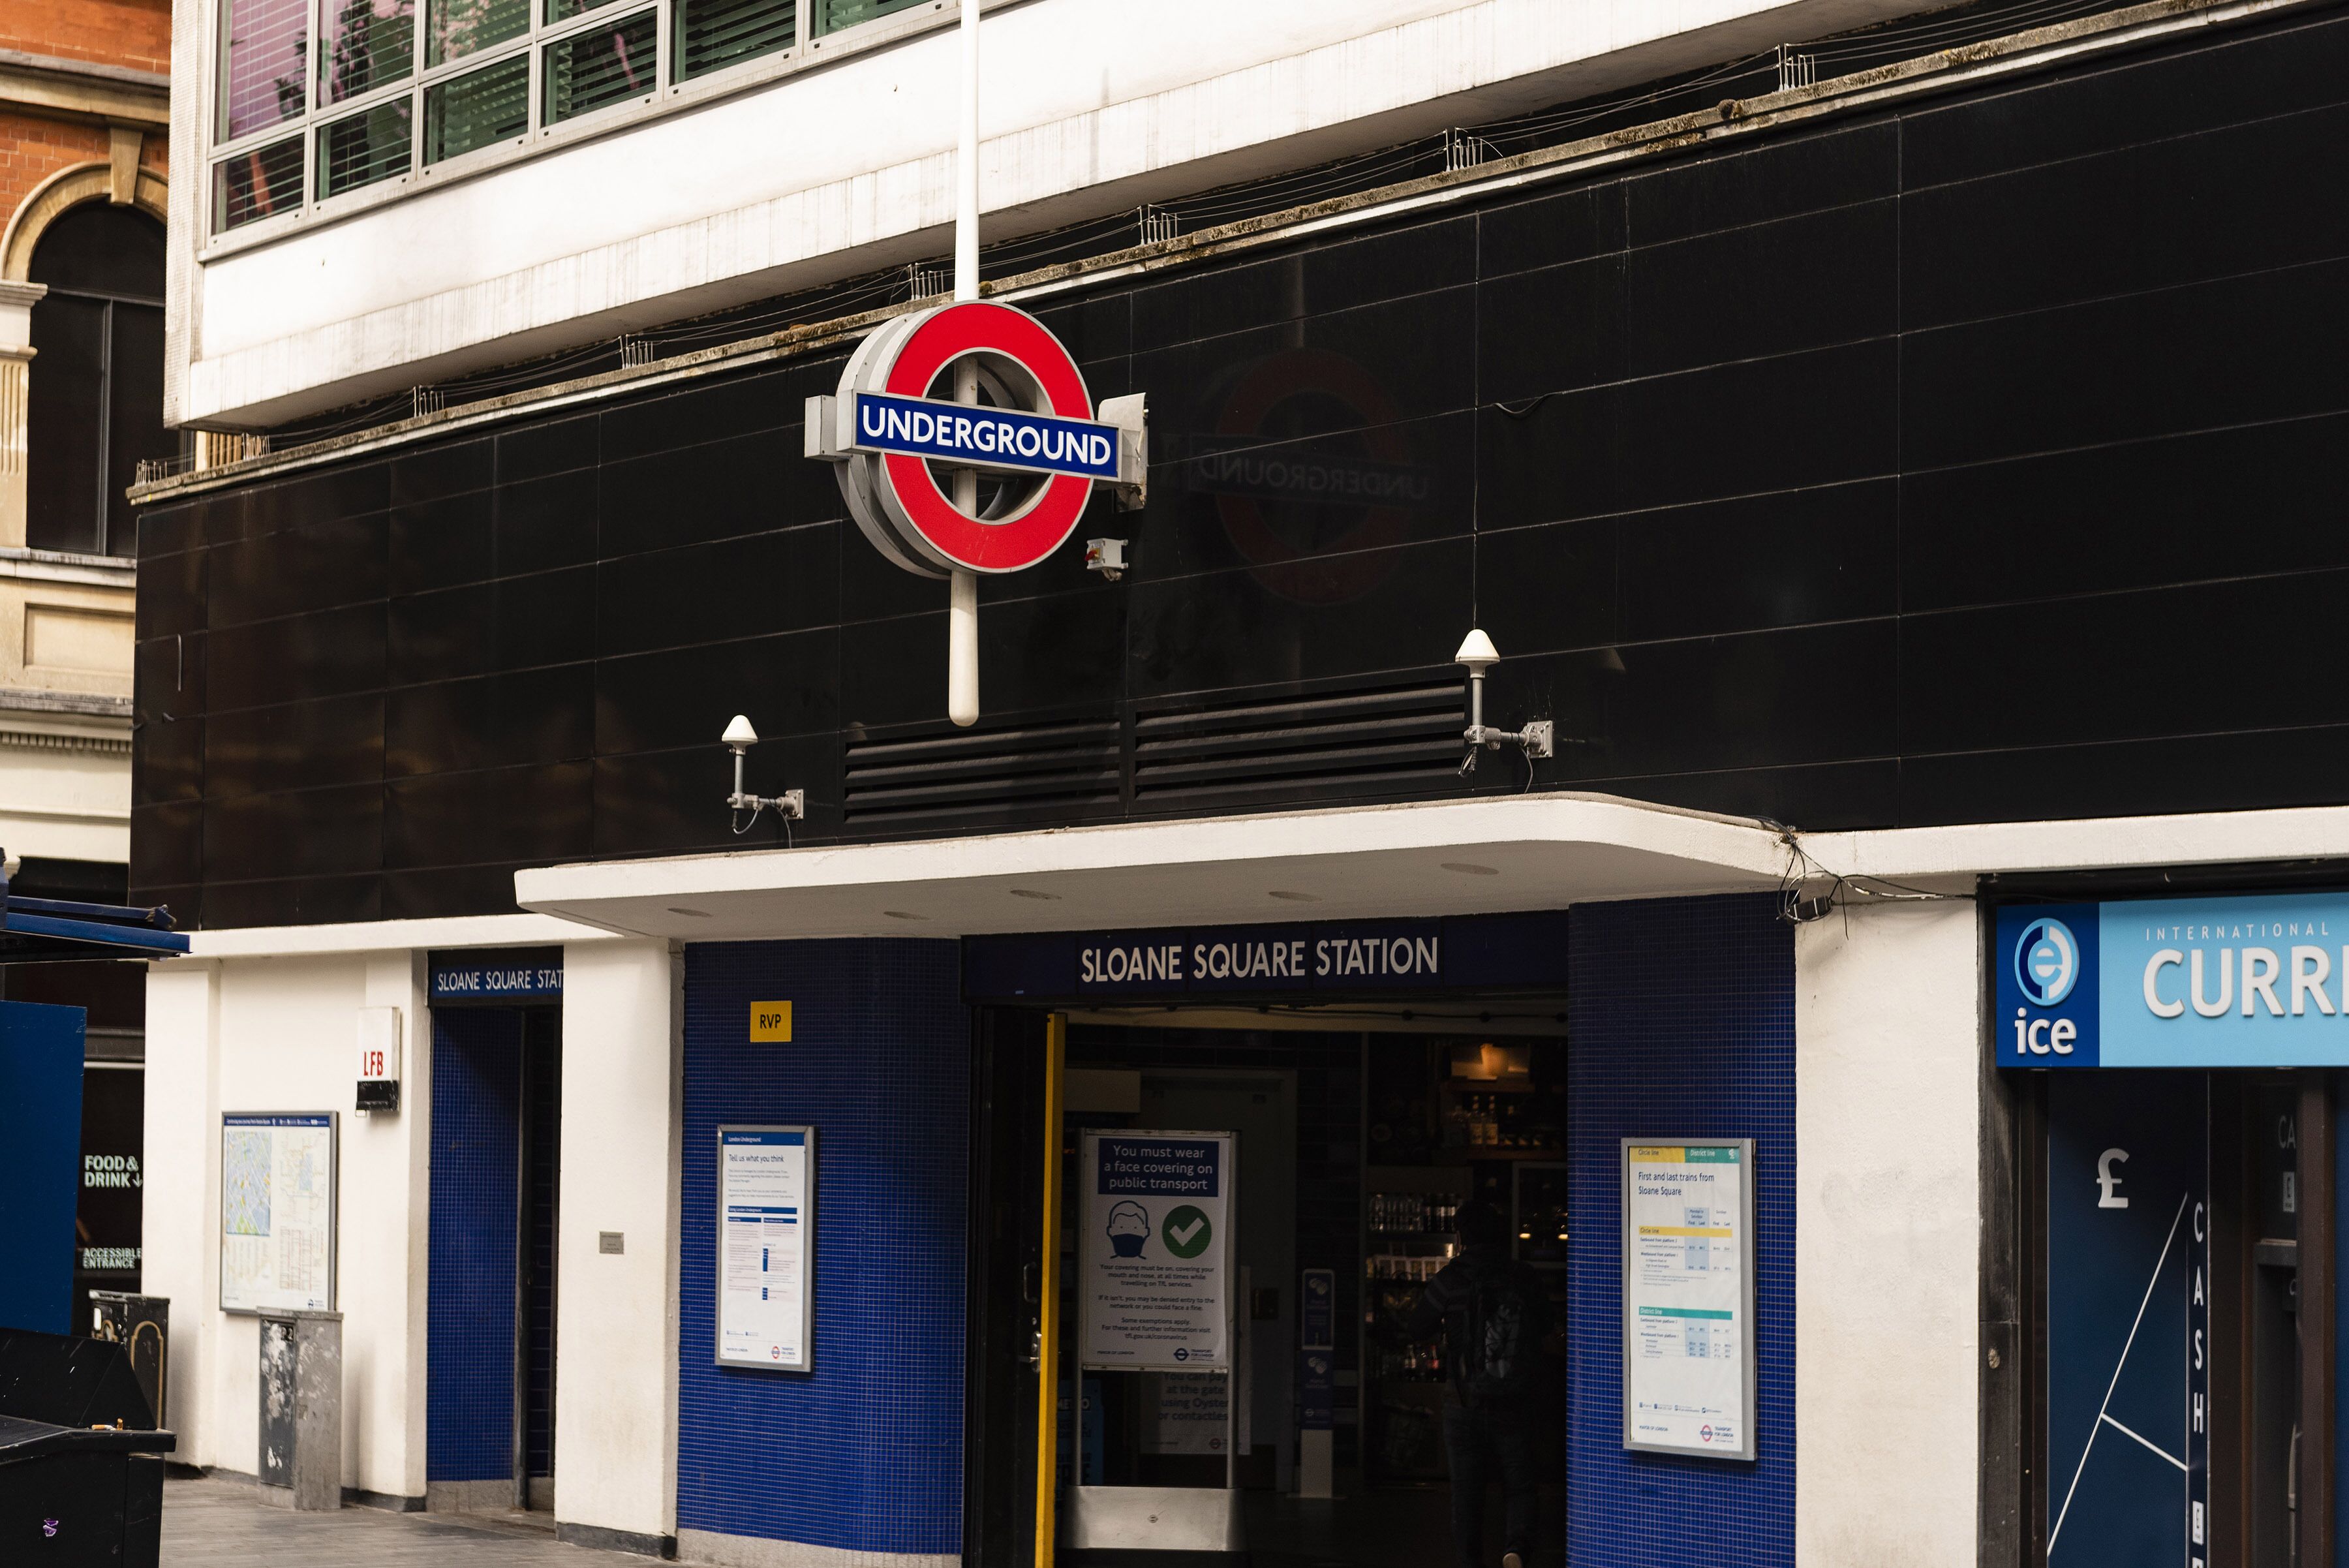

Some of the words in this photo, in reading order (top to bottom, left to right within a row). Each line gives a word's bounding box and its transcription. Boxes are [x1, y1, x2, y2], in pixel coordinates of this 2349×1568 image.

[863, 405, 1111, 465] UNDERGROUND
[2145, 922, 2329, 940] INTERNATIONAL
[1081, 945, 1182, 983] SLOANE
[1193, 942, 1306, 979] SQUARE
[1315, 937, 1437, 976] STATION
[438, 972, 480, 991] SLOANE
[485, 970, 531, 990] SQUARE
[2143, 945, 2349, 1019] CURR
[760, 1013, 781, 1028] RVP
[2014, 1007, 2077, 1054] ice
[364, 1051, 383, 1076] LFB
[1113, 1145, 1137, 1157] You
[1141, 1147, 1171, 1158] must
[1175, 1149, 1205, 1159] wear
[84, 1155, 125, 1171] FOOD
[126, 1156, 139, 1172] &
[1104, 1163, 1111, 1172] a
[1114, 1161, 1141, 1173] face
[1143, 1162, 1194, 1176] covering
[1197, 1165, 1213, 1175] on
[84, 1171, 131, 1188] DRINK
[1109, 1177, 1146, 1190] public
[1150, 1179, 1208, 1192] transport
[1638, 1172, 1651, 1181] First
[1653, 1172, 1665, 1181] and
[1666, 1173, 1678, 1182] last
[1680, 1173, 1698, 1182] trains
[1700, 1173, 1715, 1182] from
[2096, 1148, 2129, 1208] £
[1638, 1186, 1659, 1195] Sloane
[1661, 1186, 1682, 1197] Square
[83, 1248, 142, 1259] ACCESSIBLE
[82, 1257, 136, 1269] ENTRANCE
[2194, 1201, 2203, 1434] CASH
[1165, 1372, 1184, 1381] You
[1208, 1375, 1227, 1383] pay
[1180, 1385, 1199, 1394] the
[1201, 1387, 1225, 1396] gate
[1161, 1399, 1190, 1409] using
